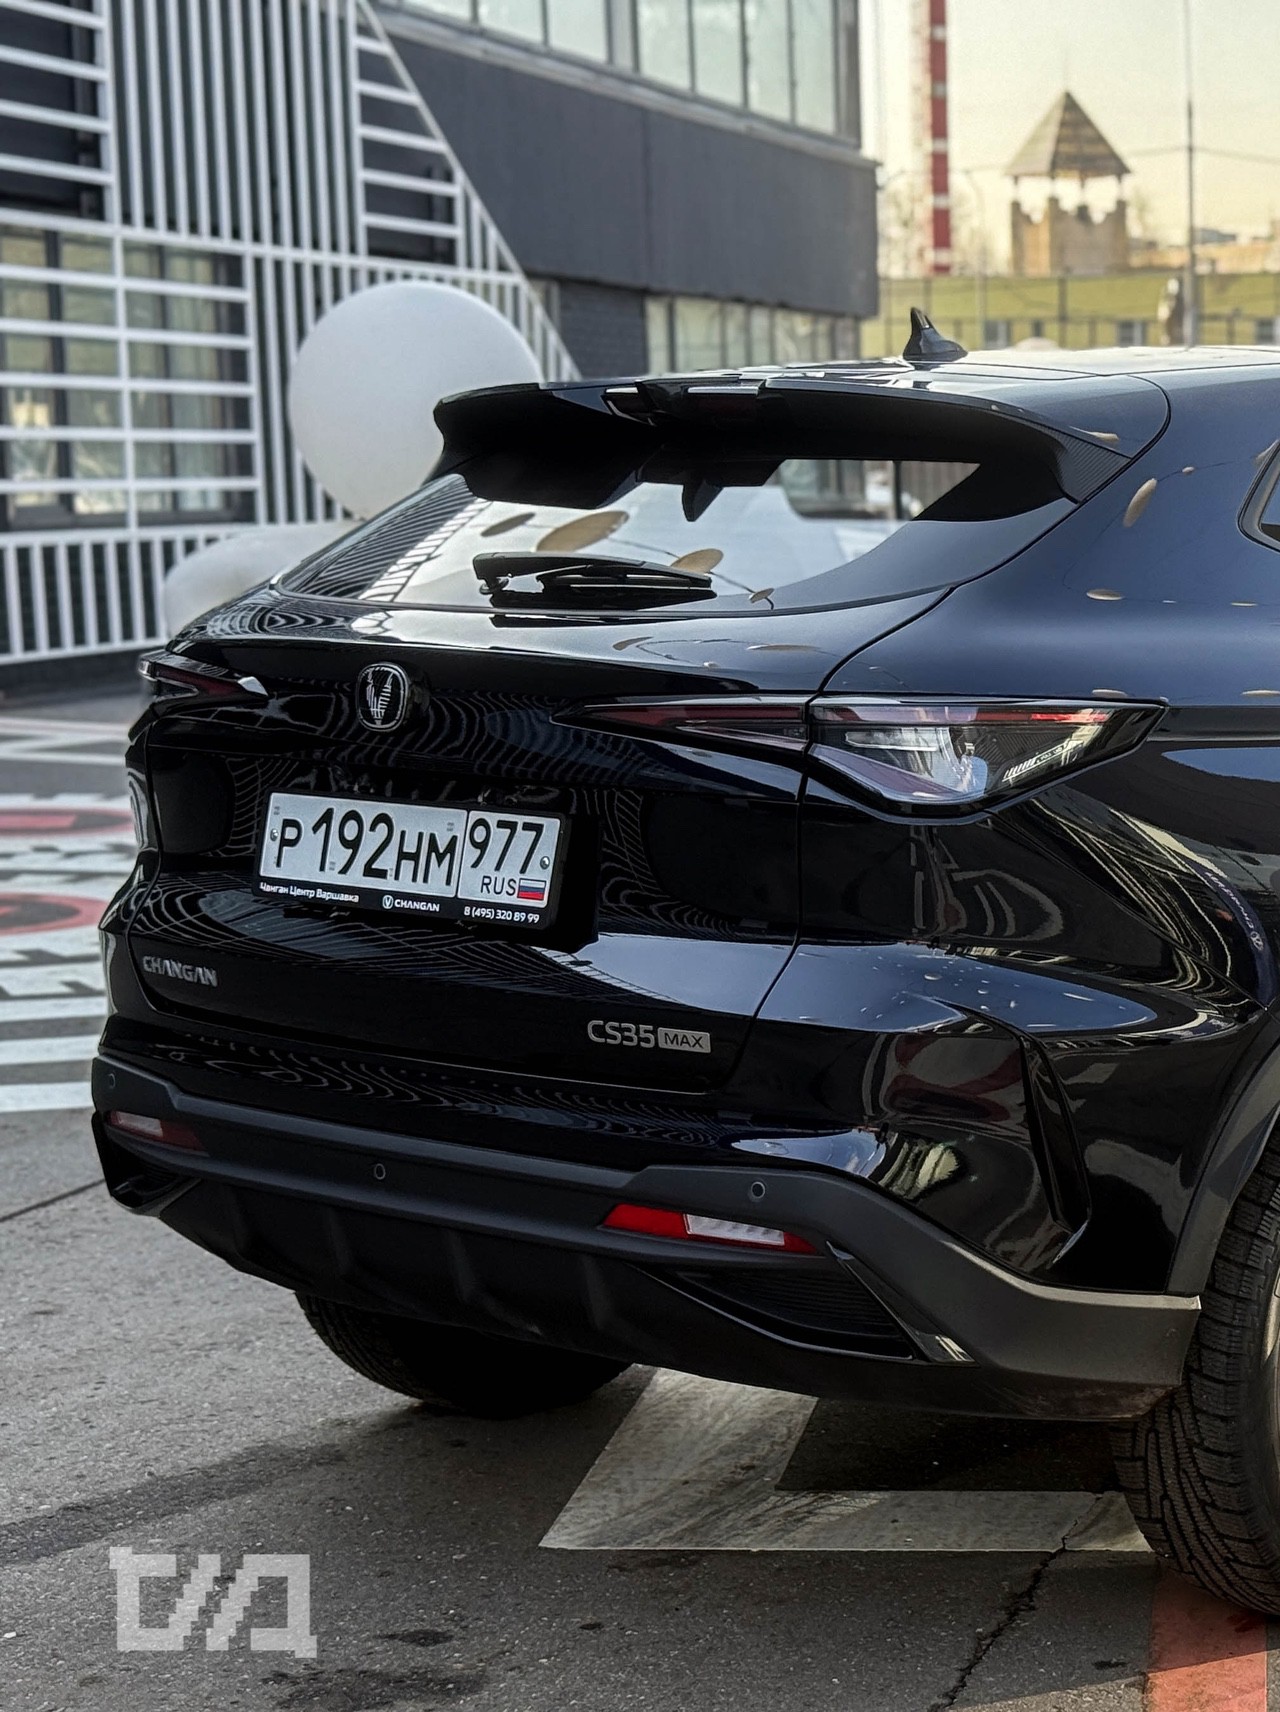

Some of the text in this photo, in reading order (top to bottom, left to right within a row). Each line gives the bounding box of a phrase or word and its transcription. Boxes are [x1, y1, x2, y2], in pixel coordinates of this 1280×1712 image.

[469, 817, 545, 875] 977
[289, 885, 316, 898] Центр
[316, 888, 359, 903] Варшавка
[480, 875, 517, 896] RUS
[394, 899, 440, 912] CHANGAN
[463, 906, 540, 924] 8 (495) 320 89 99
[143, 955, 217, 987] CHANGAN
[587, 1020, 705, 1049] CS35 MAX
